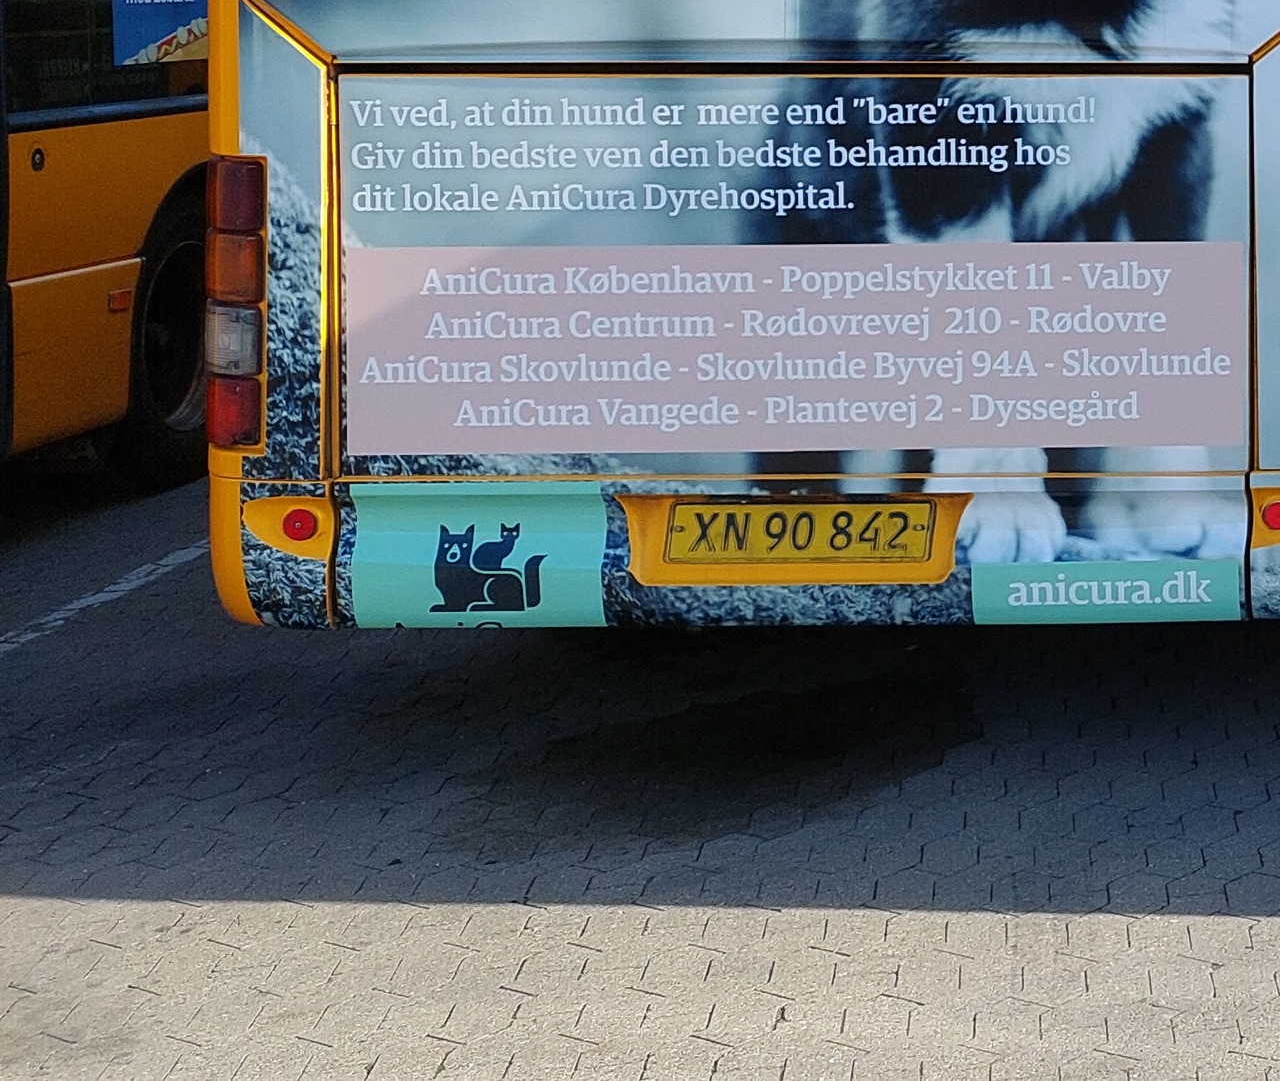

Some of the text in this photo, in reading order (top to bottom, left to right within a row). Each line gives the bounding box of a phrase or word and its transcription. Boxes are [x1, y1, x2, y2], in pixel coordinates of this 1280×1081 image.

[350, 96, 1096, 130] Vi ved, at din hund er mere end "bare" en hund!
[352, 138, 1070, 172] Giv din bedste ven den bedste behandling hos
[352, 182, 854, 216] dit lokale AniCura Dyrehospital.
[420, 267, 556, 296] AniCura
[563, 265, 755, 295] København
[781, 264, 1017, 299] Poppelstykket
[1026, 264, 1053, 290] 11
[1079, 262, 1172, 296] Valby
[425, 311, 562, 340] AniCura
[569, 311, 715, 338] Centrum
[742, 307, 929, 340] Rødovrevej
[944, 307, 1000, 334] 210
[1027, 305, 1166, 333] Rødovre
[359, 355, 493, 384] AniCura
[501, 354, 671, 383] Skovlunde
[696, 351, 866, 381] Skovlunde
[873, 350, 963, 384] Byvej
[971, 349, 1037, 378] 94A
[1062, 348, 1230, 377] Skovlunde
[454, 399, 590, 427] AniCura
[597, 397, 739, 432] Vangede
[765, 394, 917, 428] Plantevej
[924, 394, 944, 421] 2
[970, 391, 1139, 427] Dyssegård
[689, 511, 910, 554] XN 90 842
[1008, 571, 1211, 607] anicura.dk
